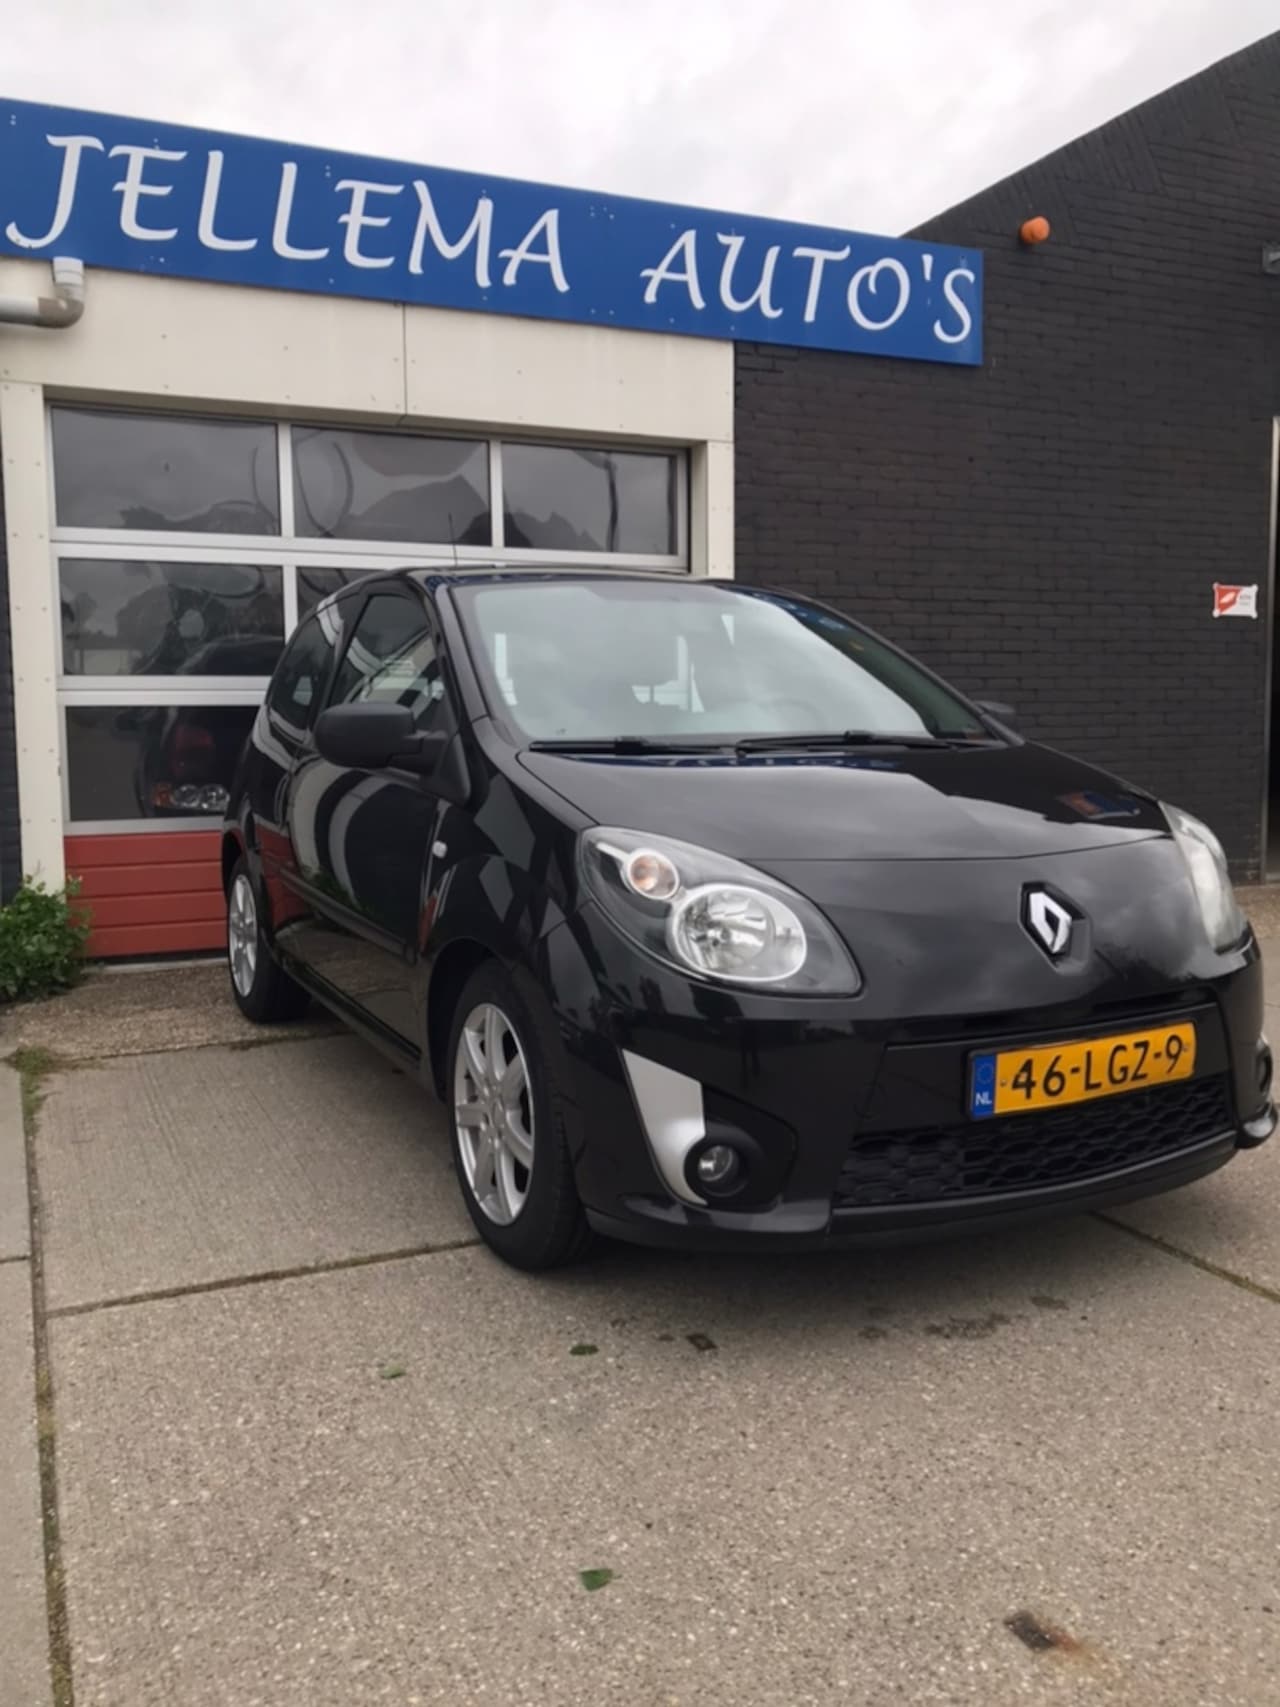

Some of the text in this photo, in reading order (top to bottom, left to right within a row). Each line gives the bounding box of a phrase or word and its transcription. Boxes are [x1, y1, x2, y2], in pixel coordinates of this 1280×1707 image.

[5, 134, 975, 343] JELLEMA AUTO'S
[975, 1091, 993, 1106] NL
[1012, 1034, 1183, 1100] 46-LGZ-9
